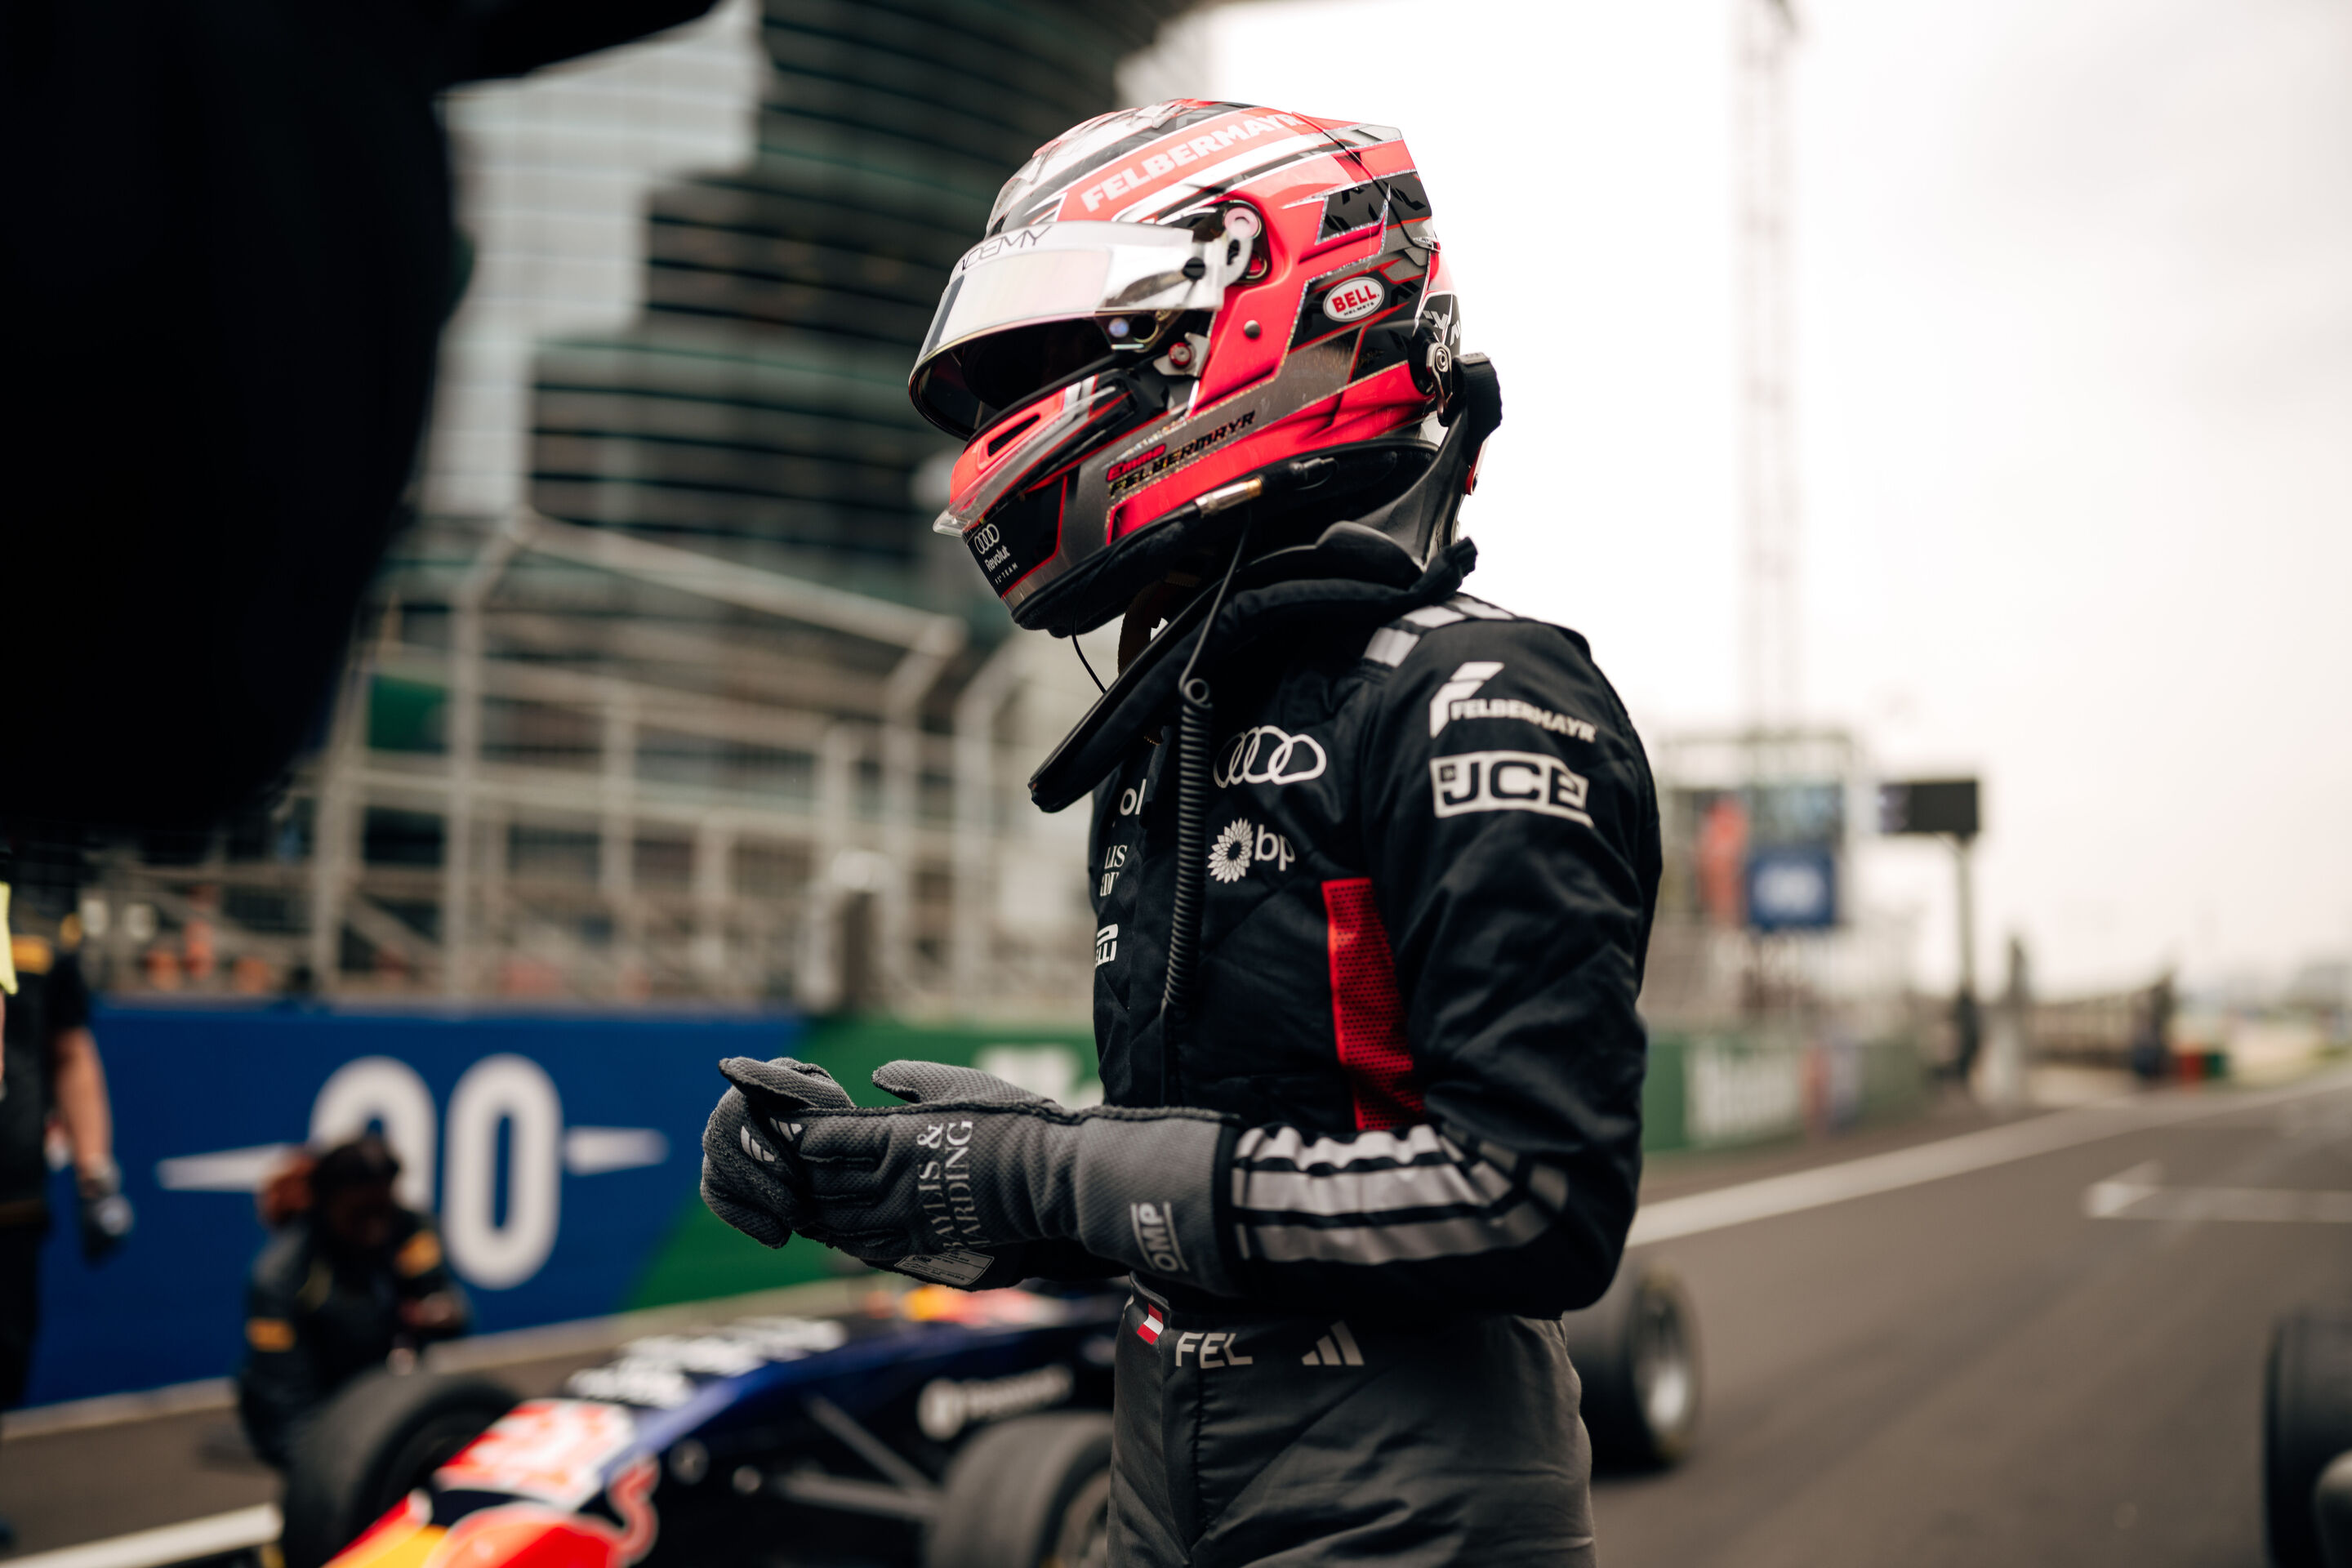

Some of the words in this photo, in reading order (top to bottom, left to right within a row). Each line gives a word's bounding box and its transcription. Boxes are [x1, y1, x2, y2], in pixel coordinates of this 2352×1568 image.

[1080, 114, 1307, 212] FELBERMAYR
[1331, 284, 1378, 314] BELL
[984, 545, 1011, 572] Revolut
[1254, 824, 1296, 871] bp
[916, 1123, 944, 1149] &
[1139, 1202, 1178, 1272] OMP
[1175, 1331, 1254, 1370] FEL
